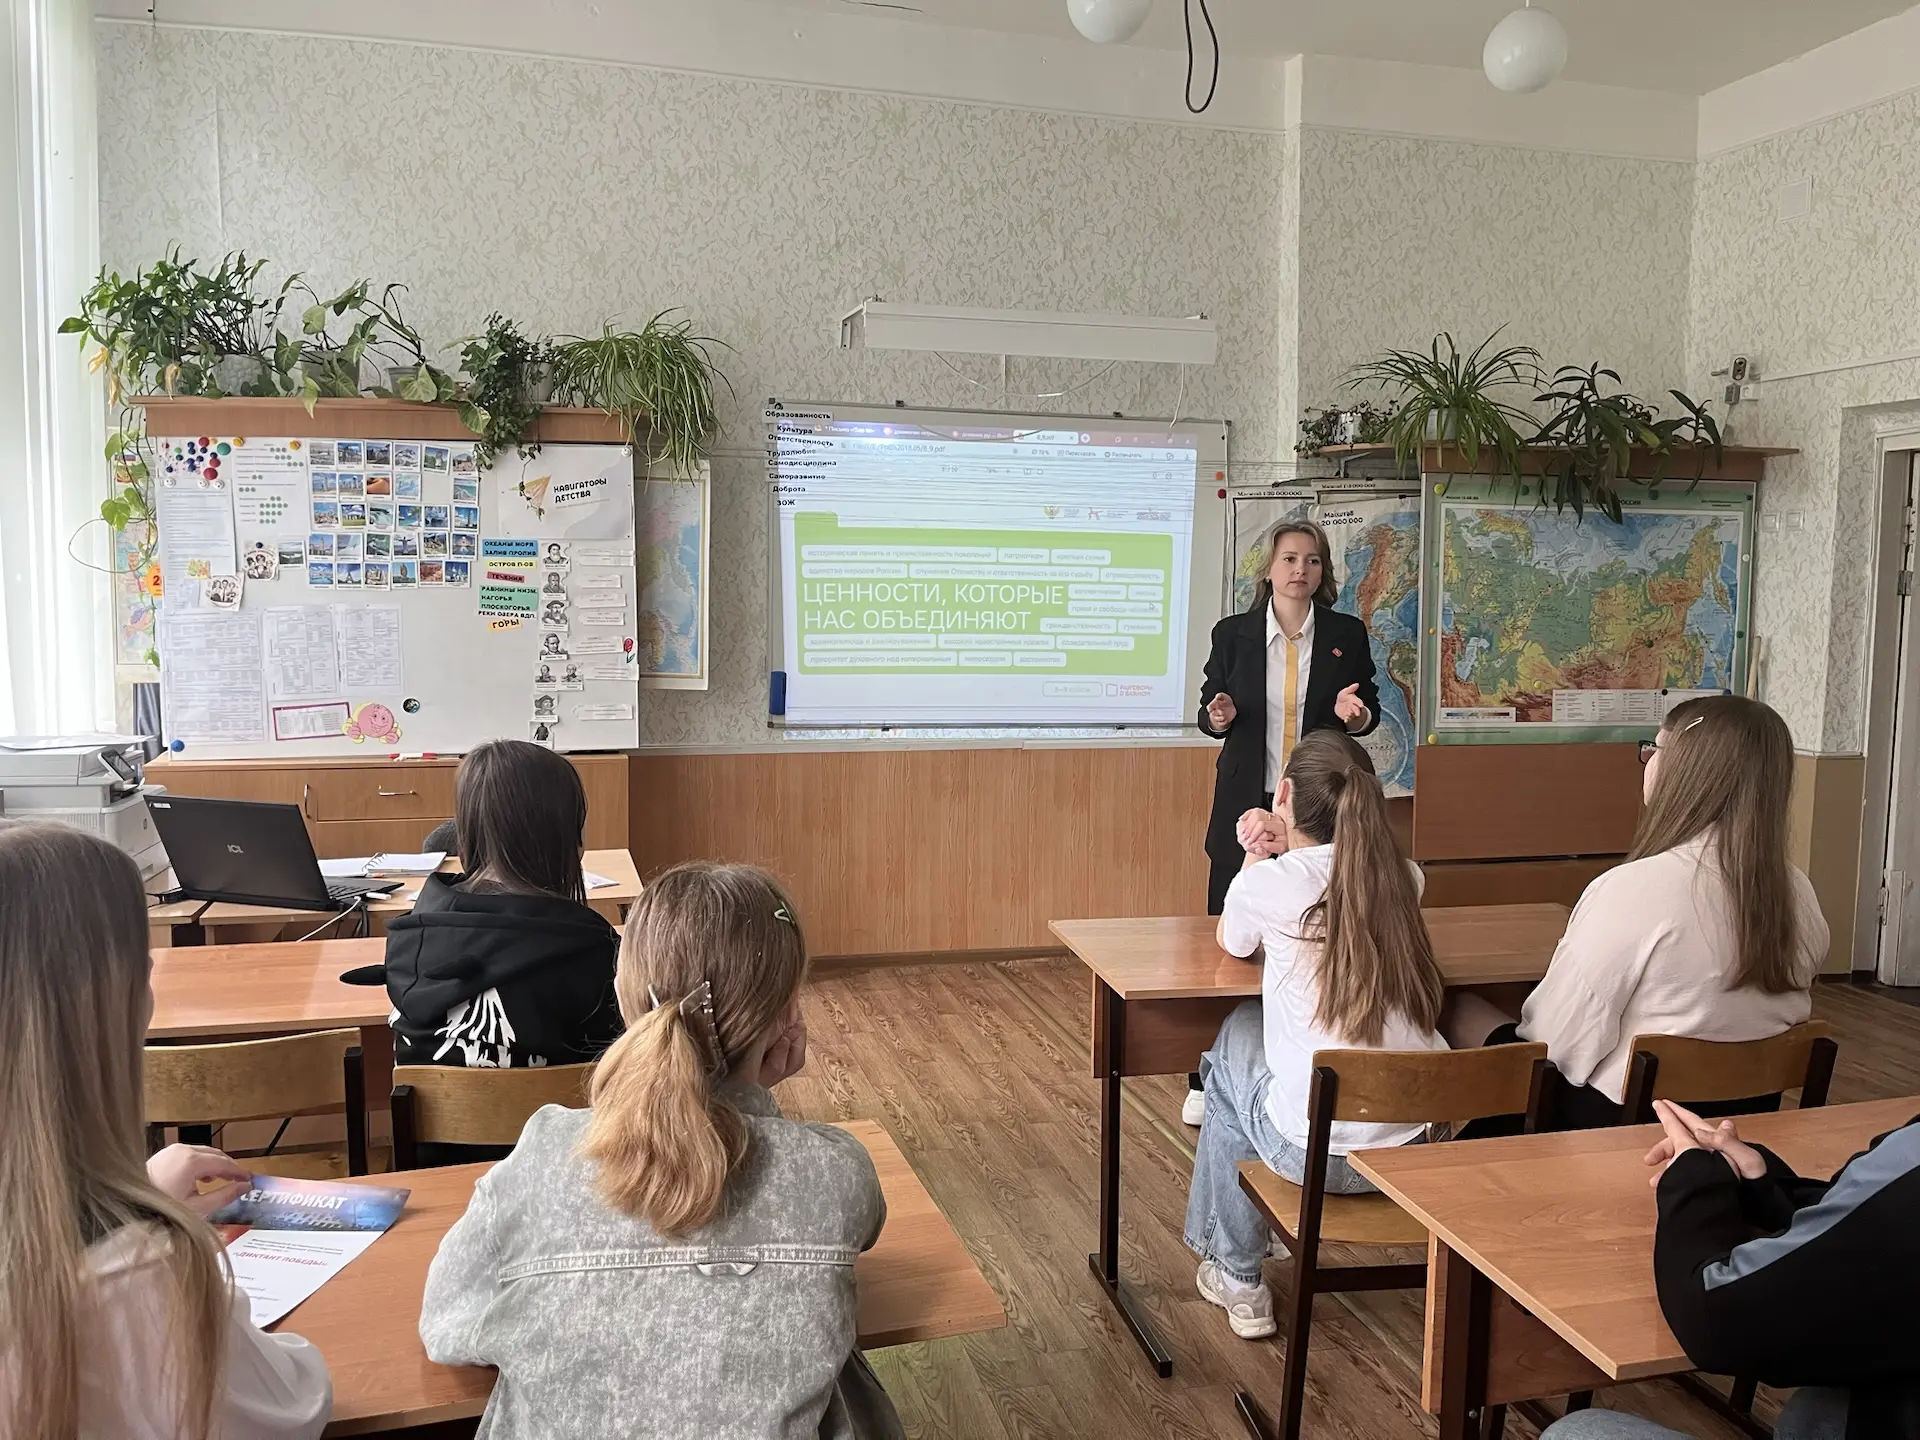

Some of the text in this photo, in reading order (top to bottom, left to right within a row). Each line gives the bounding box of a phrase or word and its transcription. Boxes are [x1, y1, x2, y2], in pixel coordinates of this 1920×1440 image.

[765, 410, 831, 419] Образованность
[776, 425, 813, 434] Культура
[768, 434, 834, 446] Ответственность
[766, 448, 816, 457] Трудолюбие
[768, 459, 837, 467] Самодисциплина
[768, 472, 826, 480] Саморазвитие
[553, 478, 607, 493] НАВИГАТОРЫ
[555, 490, 591, 503] ДЕТСТВА
[491, 573, 523, 582] ТЕЧЕНИЯ
[804, 582, 1064, 606] ЦЕННОСТИ, КОТОРЫЕ
[492, 619, 520, 629] ГОРЫ
[804, 610, 1031, 632] НАС ОБЪЕДИНЯЮТ
[241, 1189, 348, 1210] СЕРТИФИКАТ
